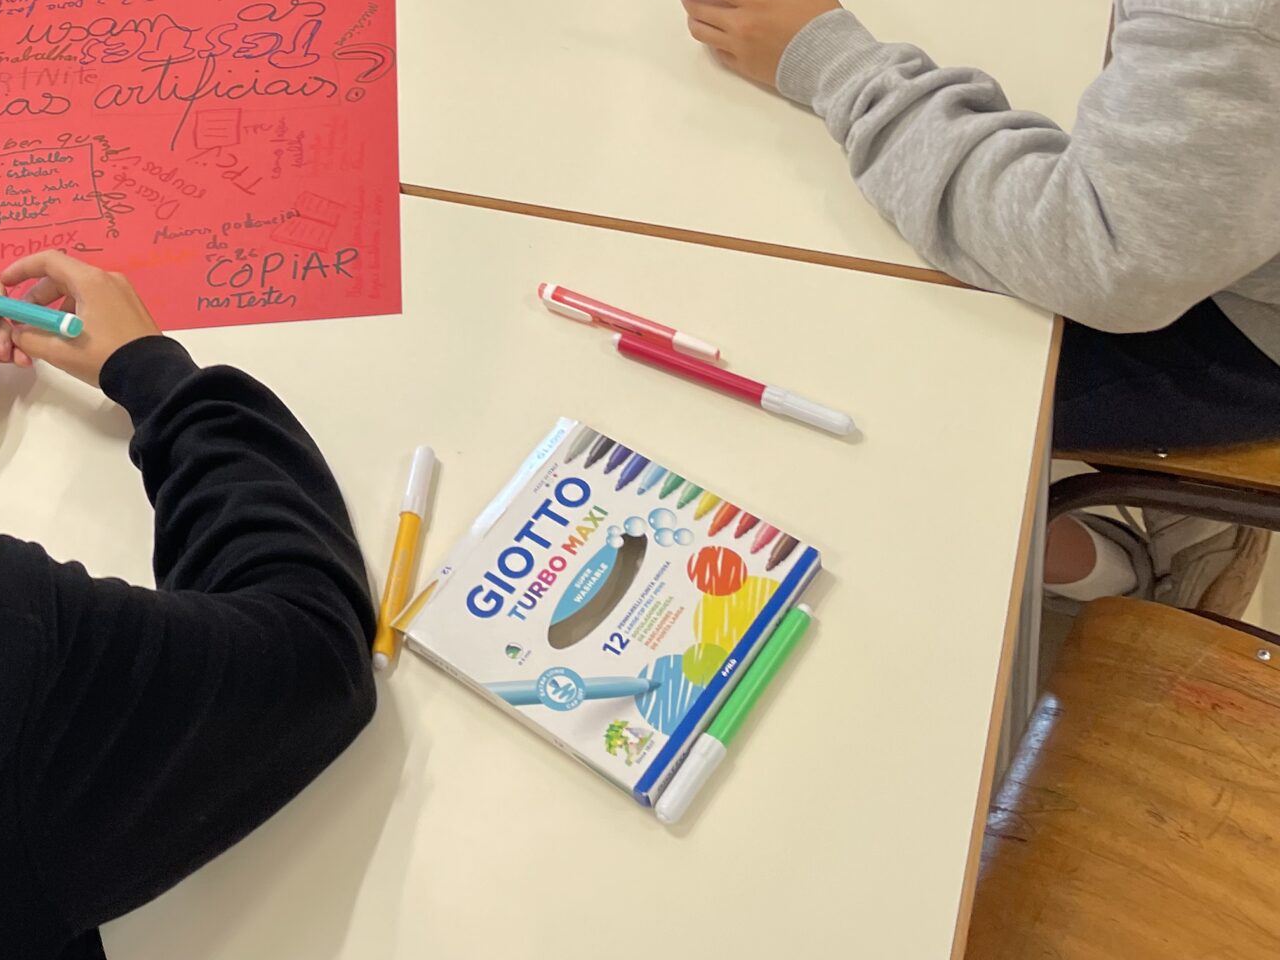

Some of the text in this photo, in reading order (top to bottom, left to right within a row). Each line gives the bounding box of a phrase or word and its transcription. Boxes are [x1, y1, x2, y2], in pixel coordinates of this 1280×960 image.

[466, 476, 591, 619] GIOTTO
[507, 505, 609, 621] TURBO MAXI
[574, 562, 609, 604] WASHABLE
[602, 632, 630, 656] 12
